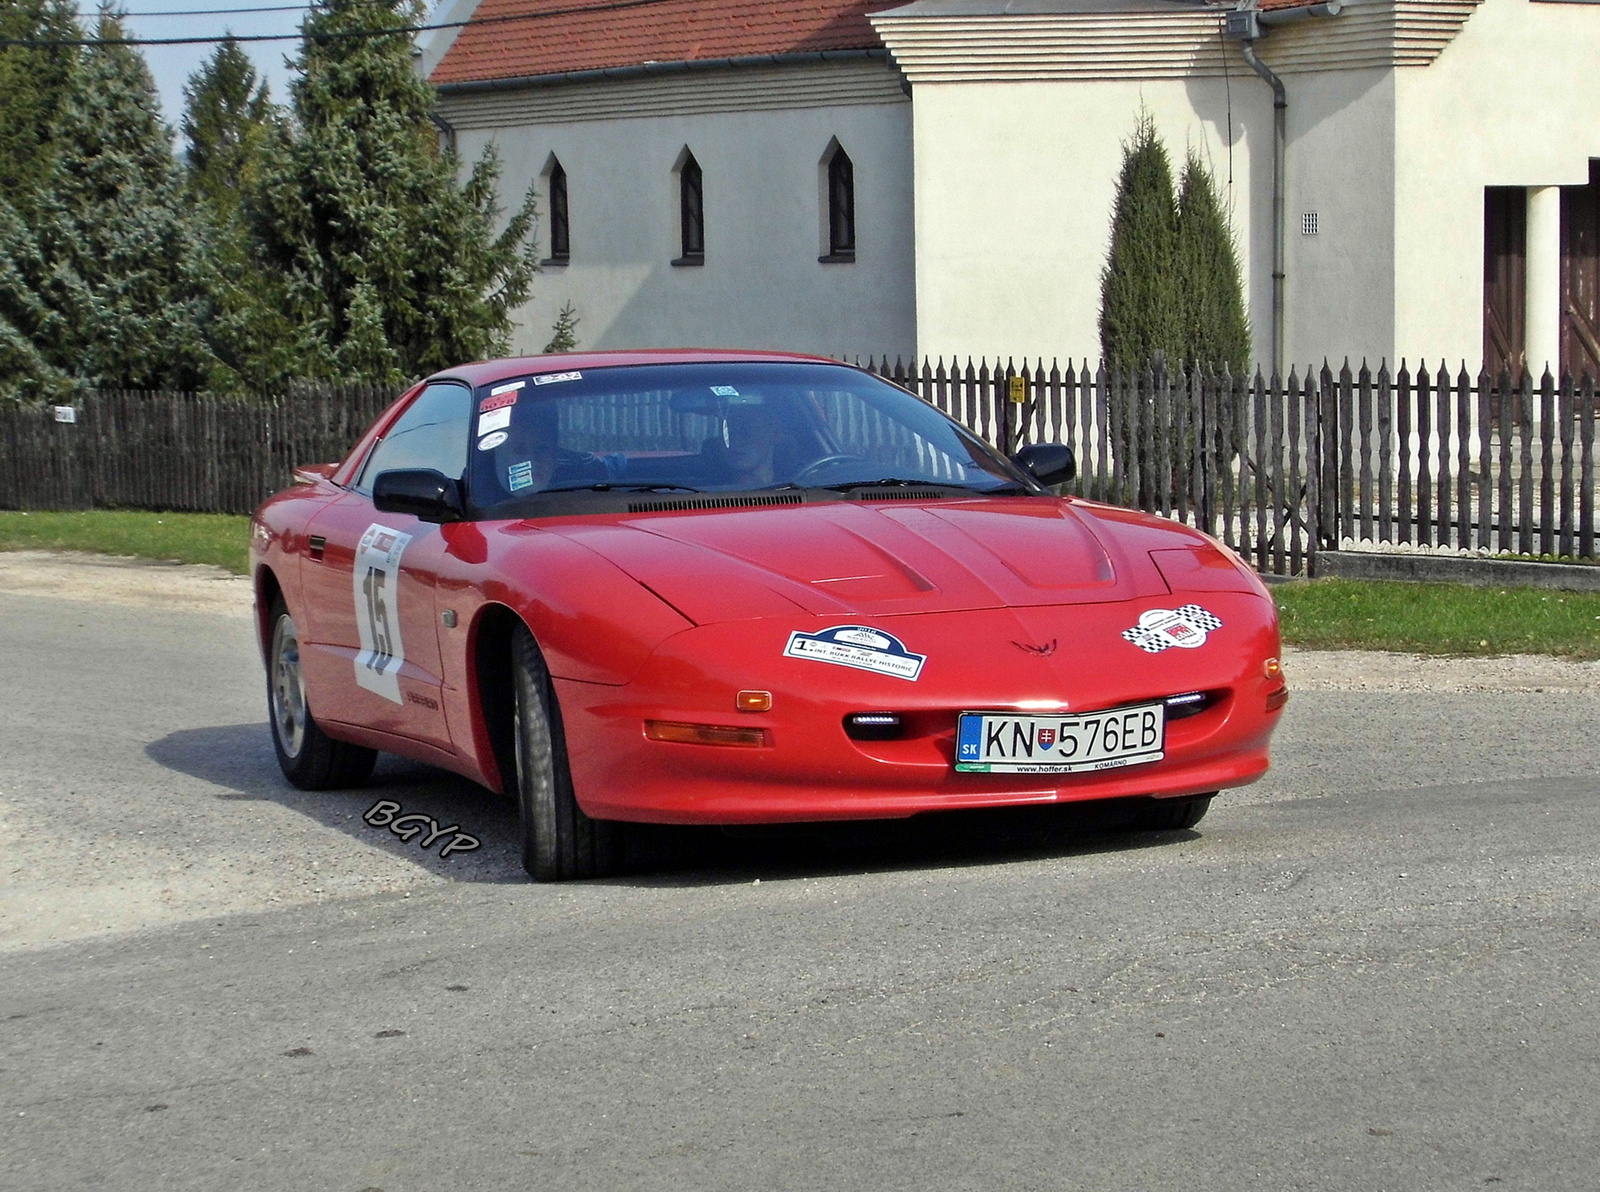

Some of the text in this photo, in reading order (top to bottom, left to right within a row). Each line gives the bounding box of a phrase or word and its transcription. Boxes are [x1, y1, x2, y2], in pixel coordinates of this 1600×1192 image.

[362, 565, 394, 676] 15
[851, 654, 877, 664] RALLYE
[878, 660, 913, 672] HISTORIC
[985, 710, 1157, 758] KN 576EB
[962, 743, 978, 755] SK
[1016, 765, 1073, 773] www.hoffer.sk
